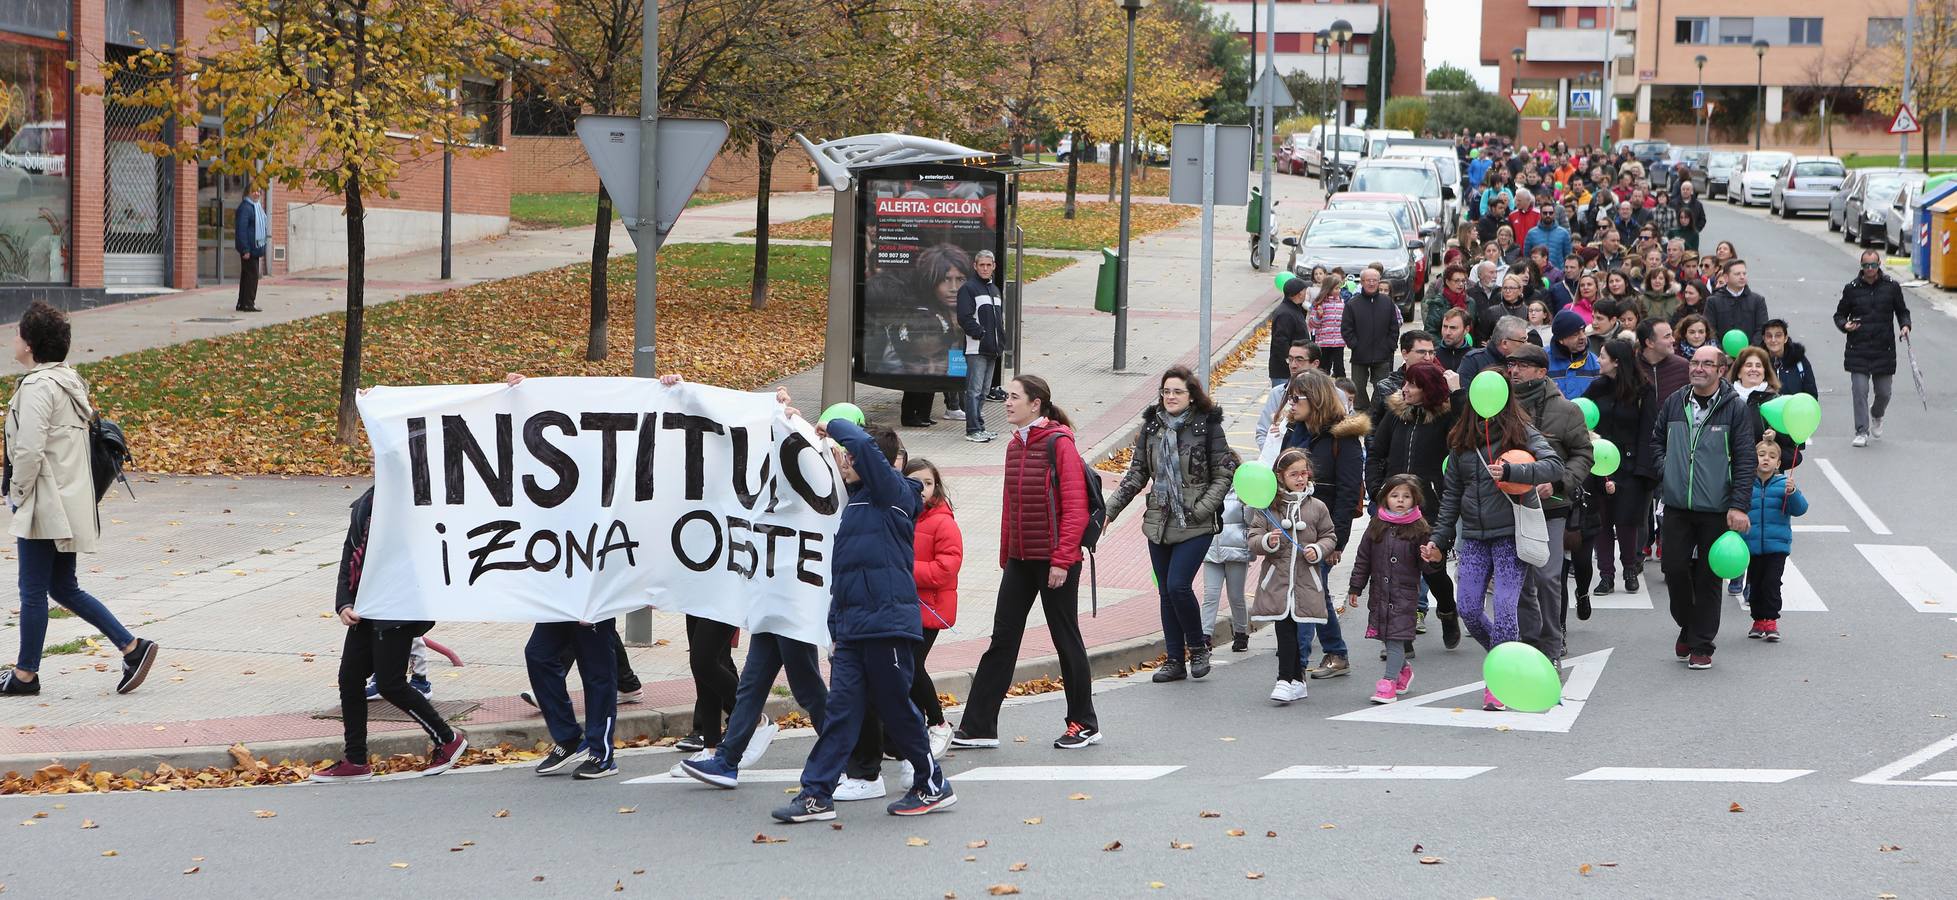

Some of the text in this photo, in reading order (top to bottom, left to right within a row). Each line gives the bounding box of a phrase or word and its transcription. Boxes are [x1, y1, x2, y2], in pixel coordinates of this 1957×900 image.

[879, 200, 981, 214] ALERTA: CICLÓN
[407, 411, 839, 516] INSTITUO
[435, 522, 451, 586] i
[466, 519, 639, 586] ZONA
